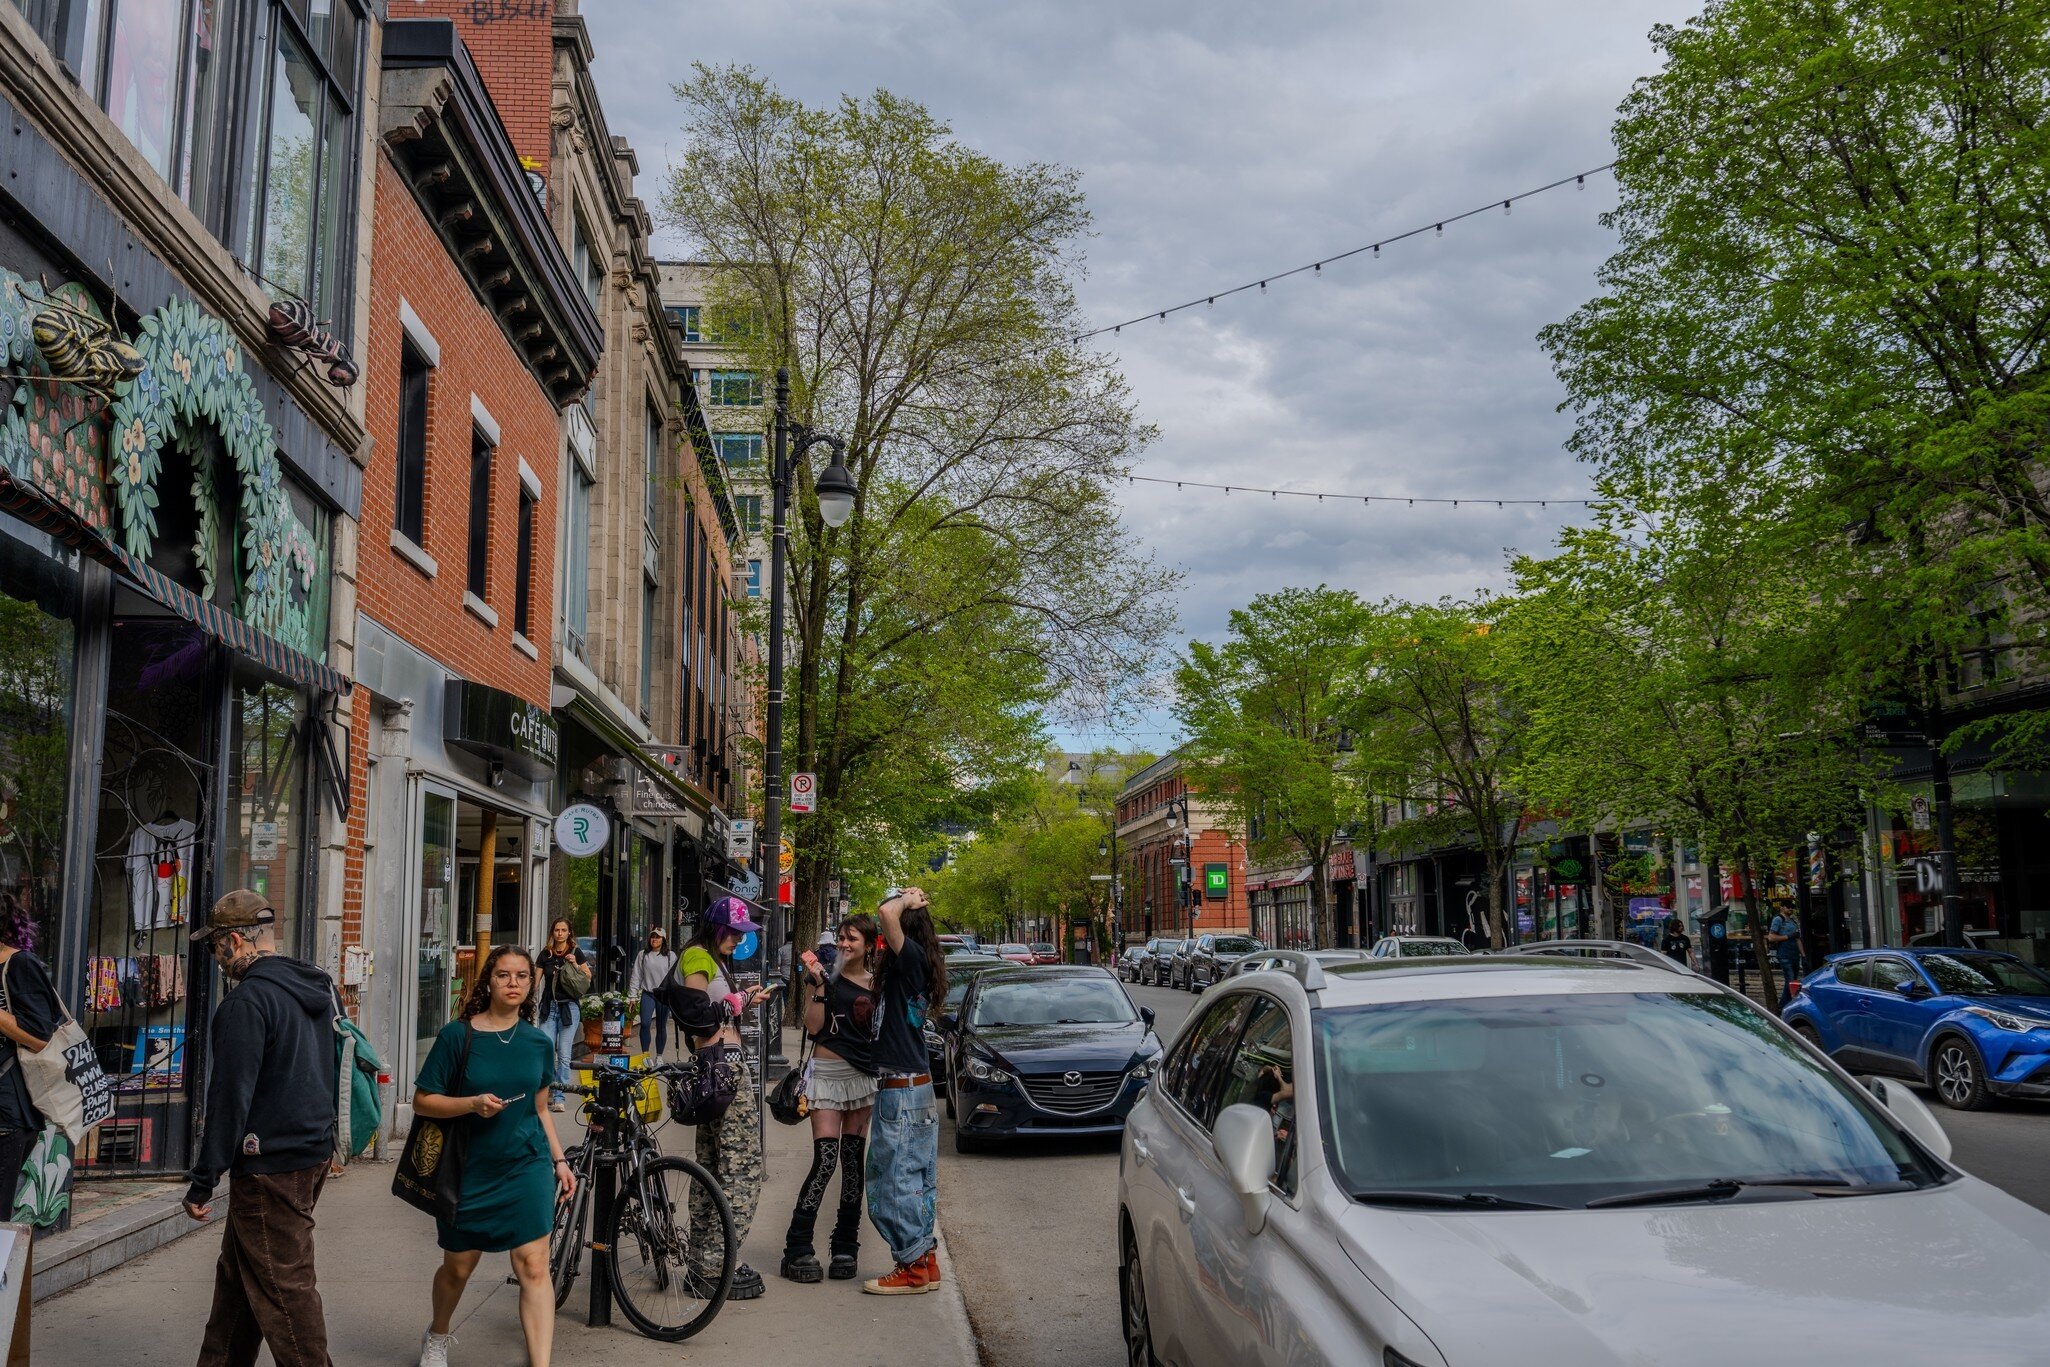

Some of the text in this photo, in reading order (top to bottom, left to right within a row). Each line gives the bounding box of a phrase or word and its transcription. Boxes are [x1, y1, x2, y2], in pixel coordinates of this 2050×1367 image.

[510, 711, 541, 745] CAFÉ
[636, 790, 654, 799] Fine
[643, 800, 677, 809] chinoise
[1210, 874, 1225, 885] TD
[82, 1076, 109, 1098] CLASS
